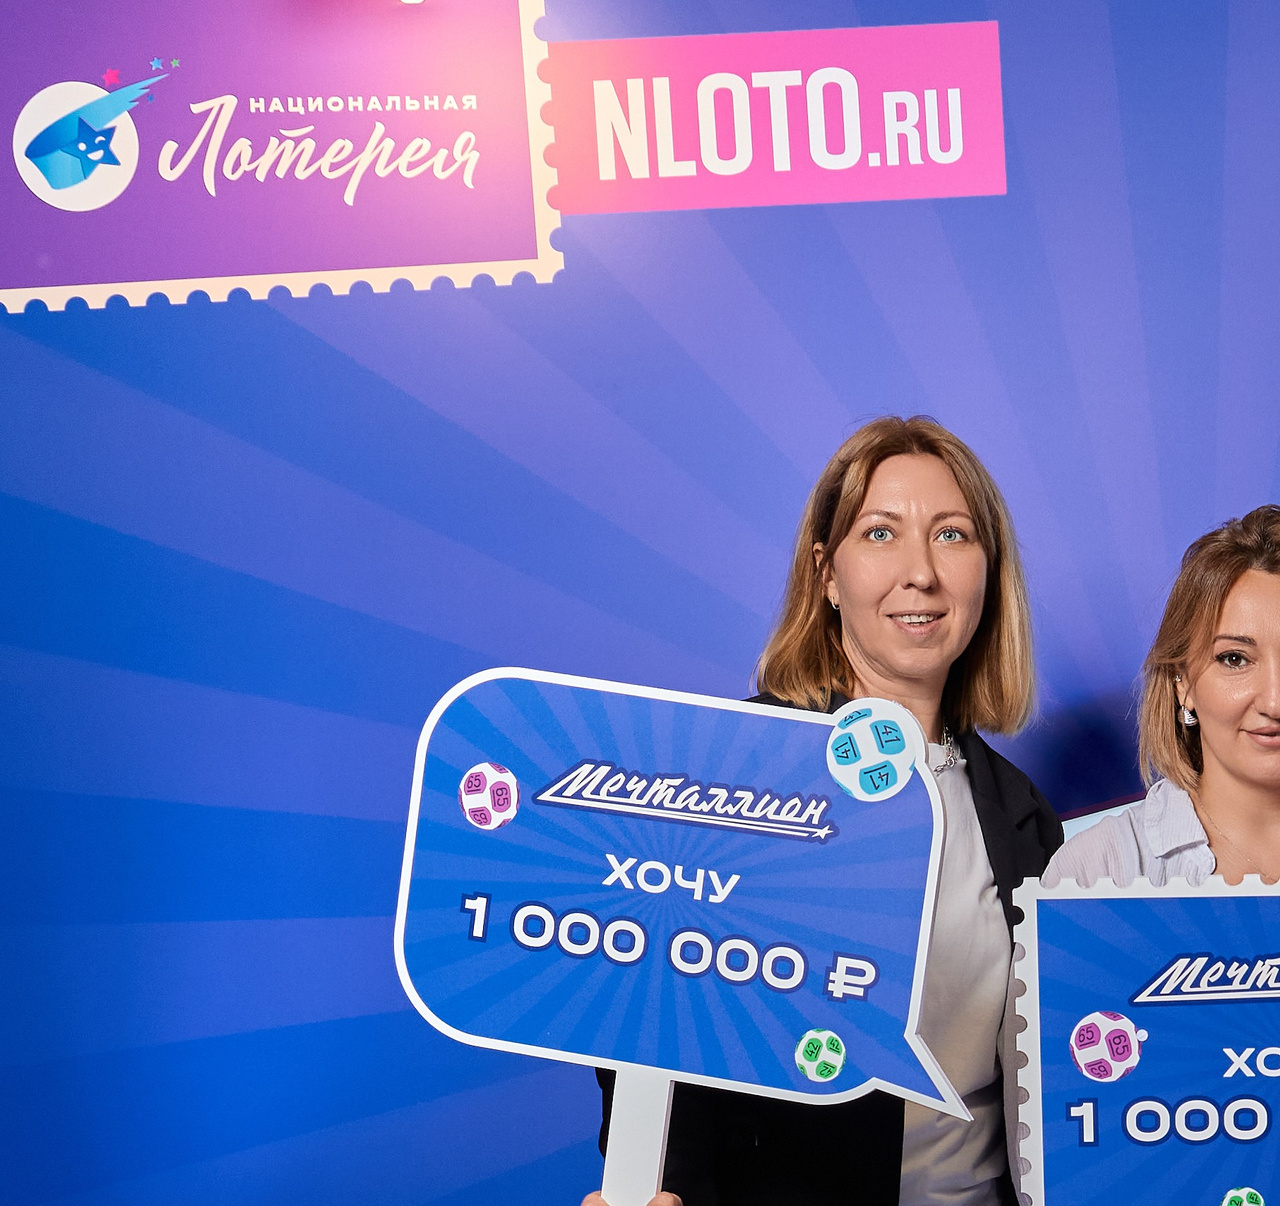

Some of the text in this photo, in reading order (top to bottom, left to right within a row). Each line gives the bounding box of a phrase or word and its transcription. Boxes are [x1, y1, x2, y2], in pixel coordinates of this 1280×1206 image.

[250, 95, 478, 115] НАЦИОНАЛЬНАЯ
[593, 67, 963, 181] NLOTO.RU
[158, 95, 480, 205] Лотерея
[882, 725, 901, 742] 41
[835, 742, 850, 758] 41
[467, 775, 481, 788] 65
[496, 788, 508, 806] 65
[536, 763, 833, 839] Мечталлион
[602, 854, 741, 903] ХОЧУ
[464, 897, 487, 938] 1
[513, 904, 645, 962] 000
[670, 931, 804, 990] 000
[1079, 1026, 1094, 1042] 65
[1113, 1035, 1129, 1055] 65
[1070, 1102, 1094, 1143] 1
[1126, 1099, 1268, 1142] 000
